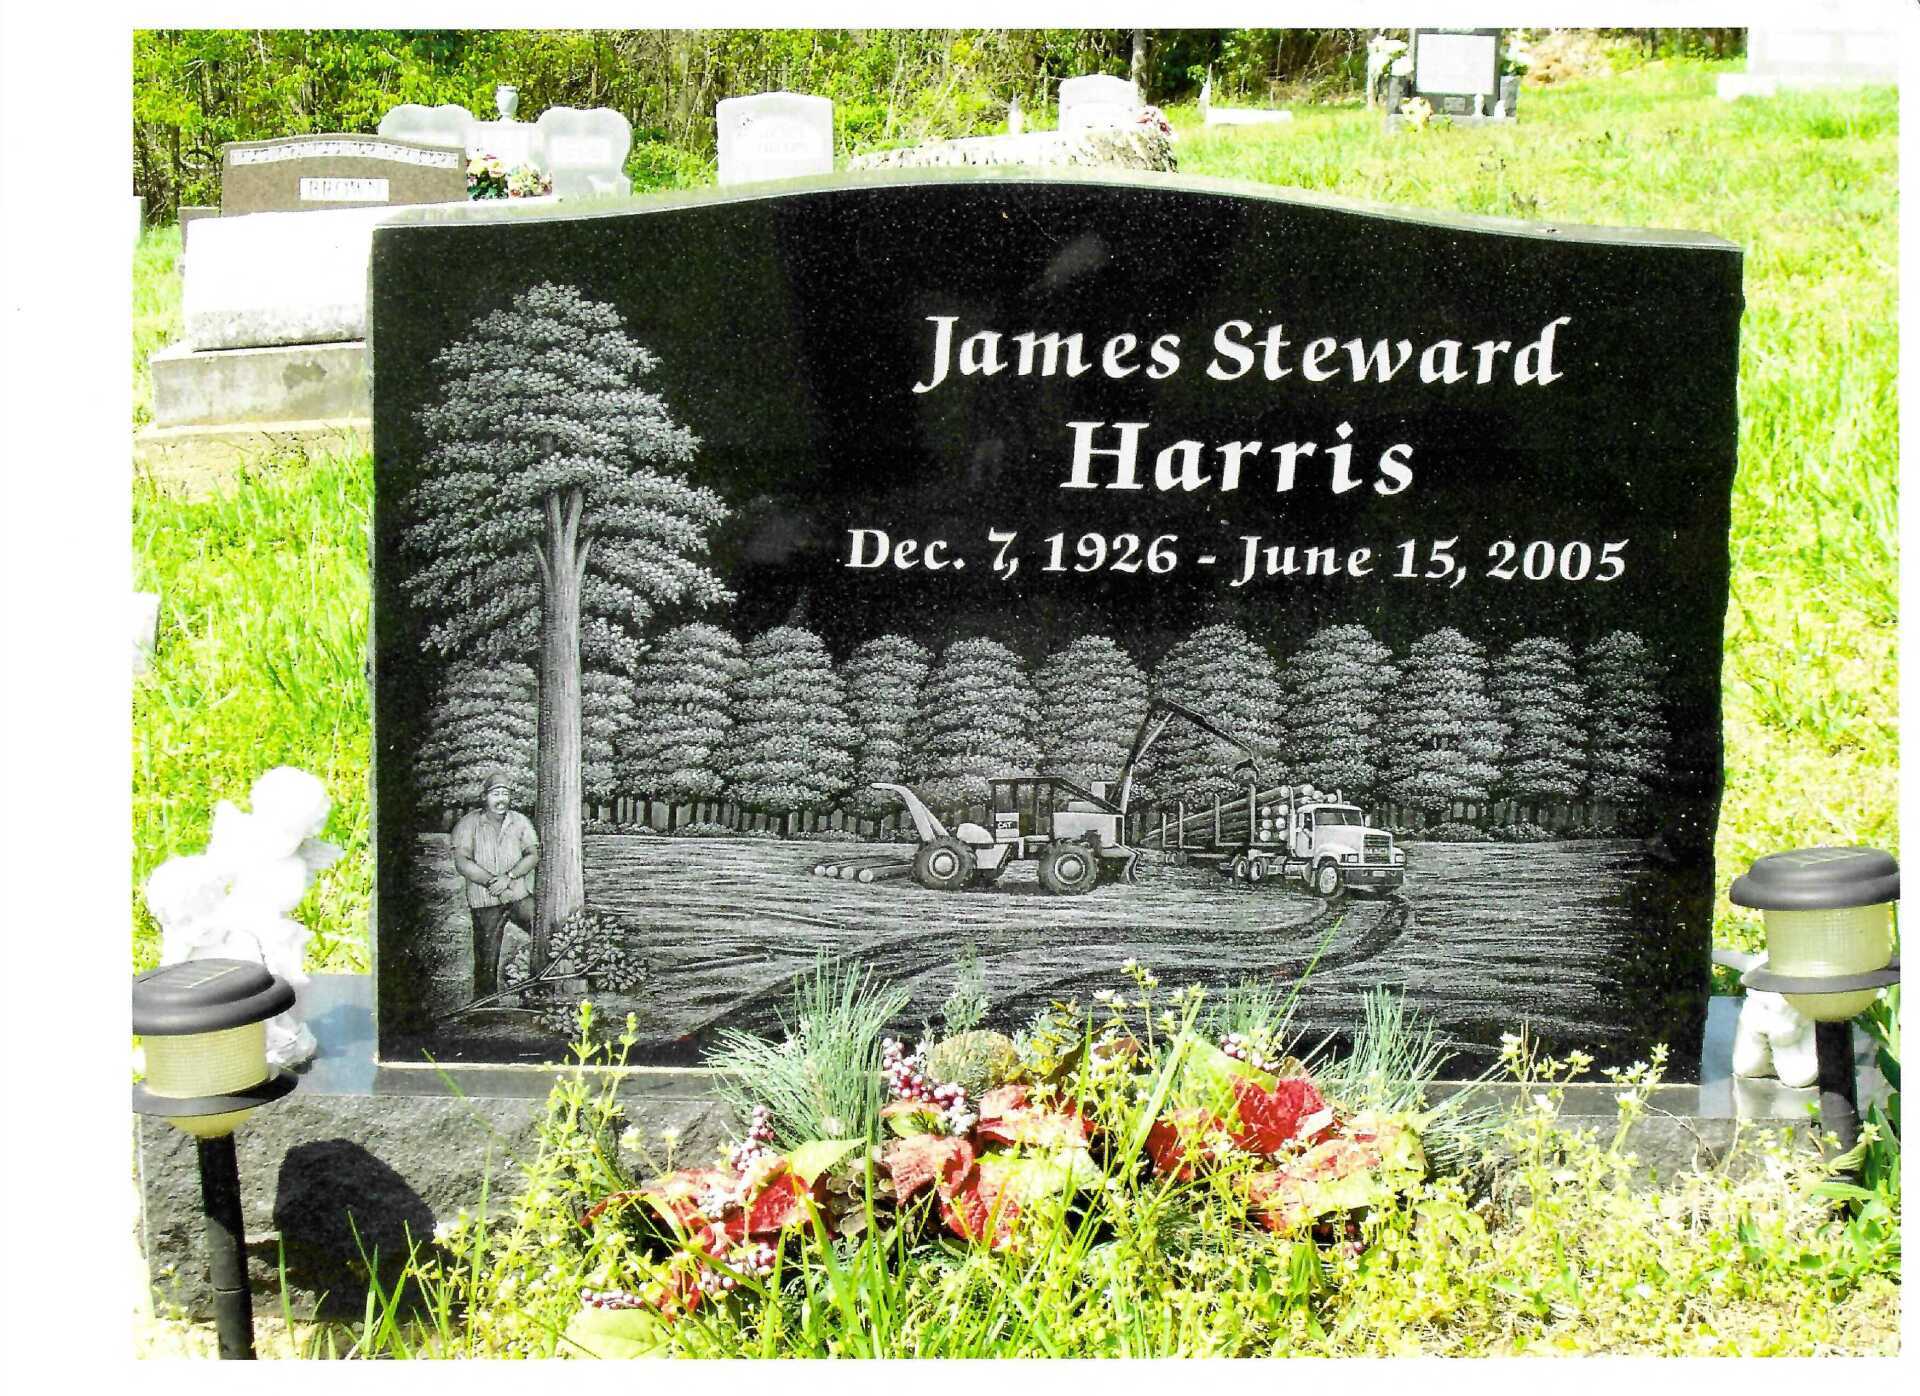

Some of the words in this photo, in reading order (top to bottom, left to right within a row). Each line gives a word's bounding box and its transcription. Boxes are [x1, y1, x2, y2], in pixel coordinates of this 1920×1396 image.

[912, 316, 1180, 393] James
[1207, 317, 1571, 386] Steward
[1060, 422, 1413, 495] Harris
[845, 529, 967, 572] Dec.
[988, 528, 1018, 581] 7,
[1043, 532, 1178, 574] 1926
[1230, 536, 1374, 587] June
[1394, 539, 1467, 589] 15,
[1487, 541, 1629, 582] 2005
[997, 821, 1013, 829] CAT
